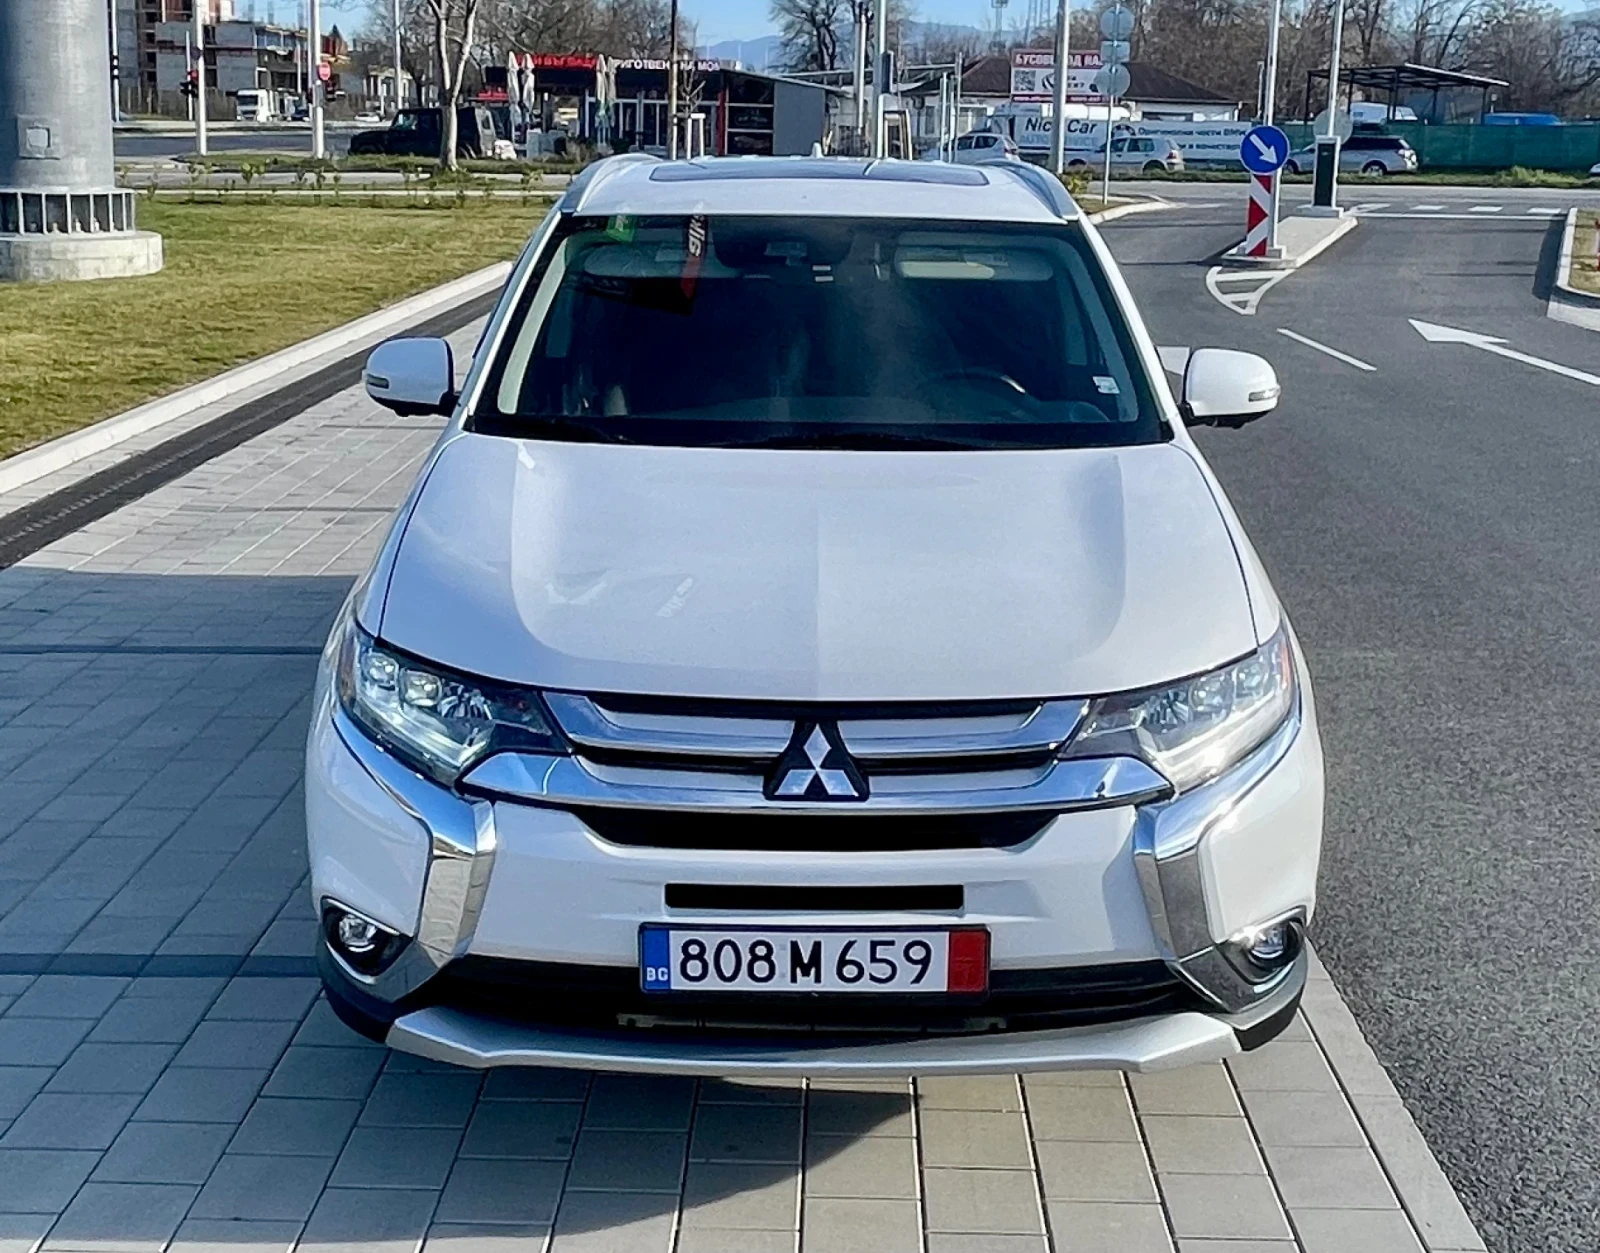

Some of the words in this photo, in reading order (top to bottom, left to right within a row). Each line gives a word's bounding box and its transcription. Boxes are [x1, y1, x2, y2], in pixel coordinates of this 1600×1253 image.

[1025, 117, 1053, 132] Nic
[1067, 120, 1097, 134] Car
[679, 938, 777, 984] 808
[789, 940, 822, 985] M
[835, 939, 932, 985] 659
